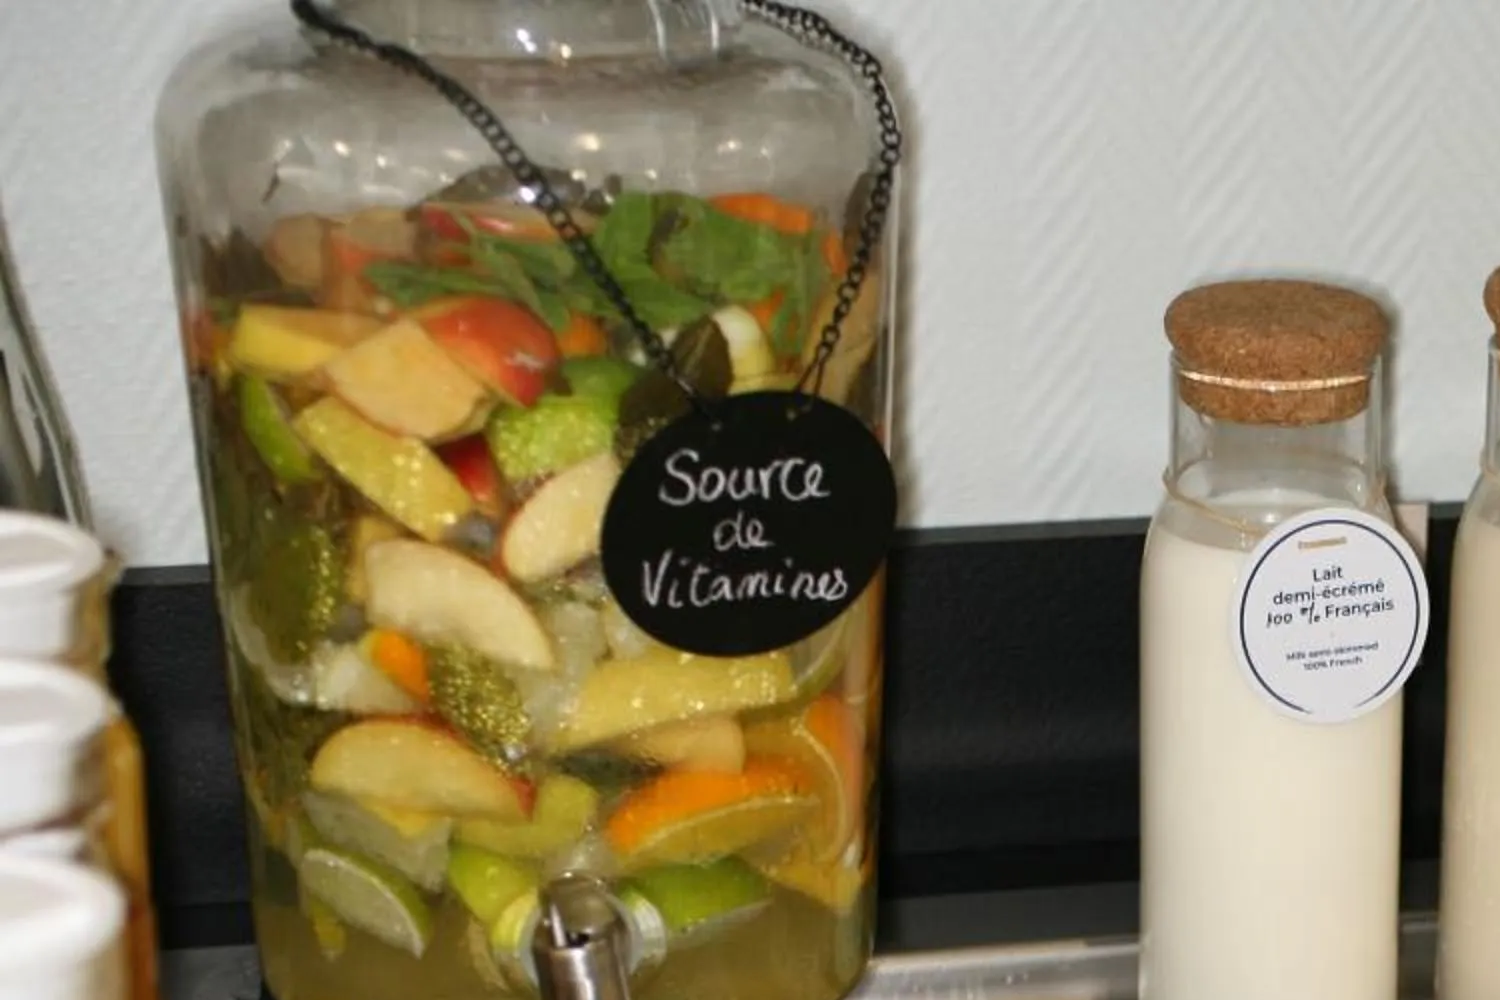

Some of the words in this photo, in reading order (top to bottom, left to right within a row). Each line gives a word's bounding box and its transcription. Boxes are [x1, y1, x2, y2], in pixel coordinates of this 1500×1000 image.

[658, 448, 831, 506] Source
[712, 510, 775, 551] de
[641, 549, 848, 608] Vitamines
[1312, 565, 1343, 582] Lait
[1272, 578, 1385, 605] demi-écrémé
[1325, 600, 1394, 620] Français
